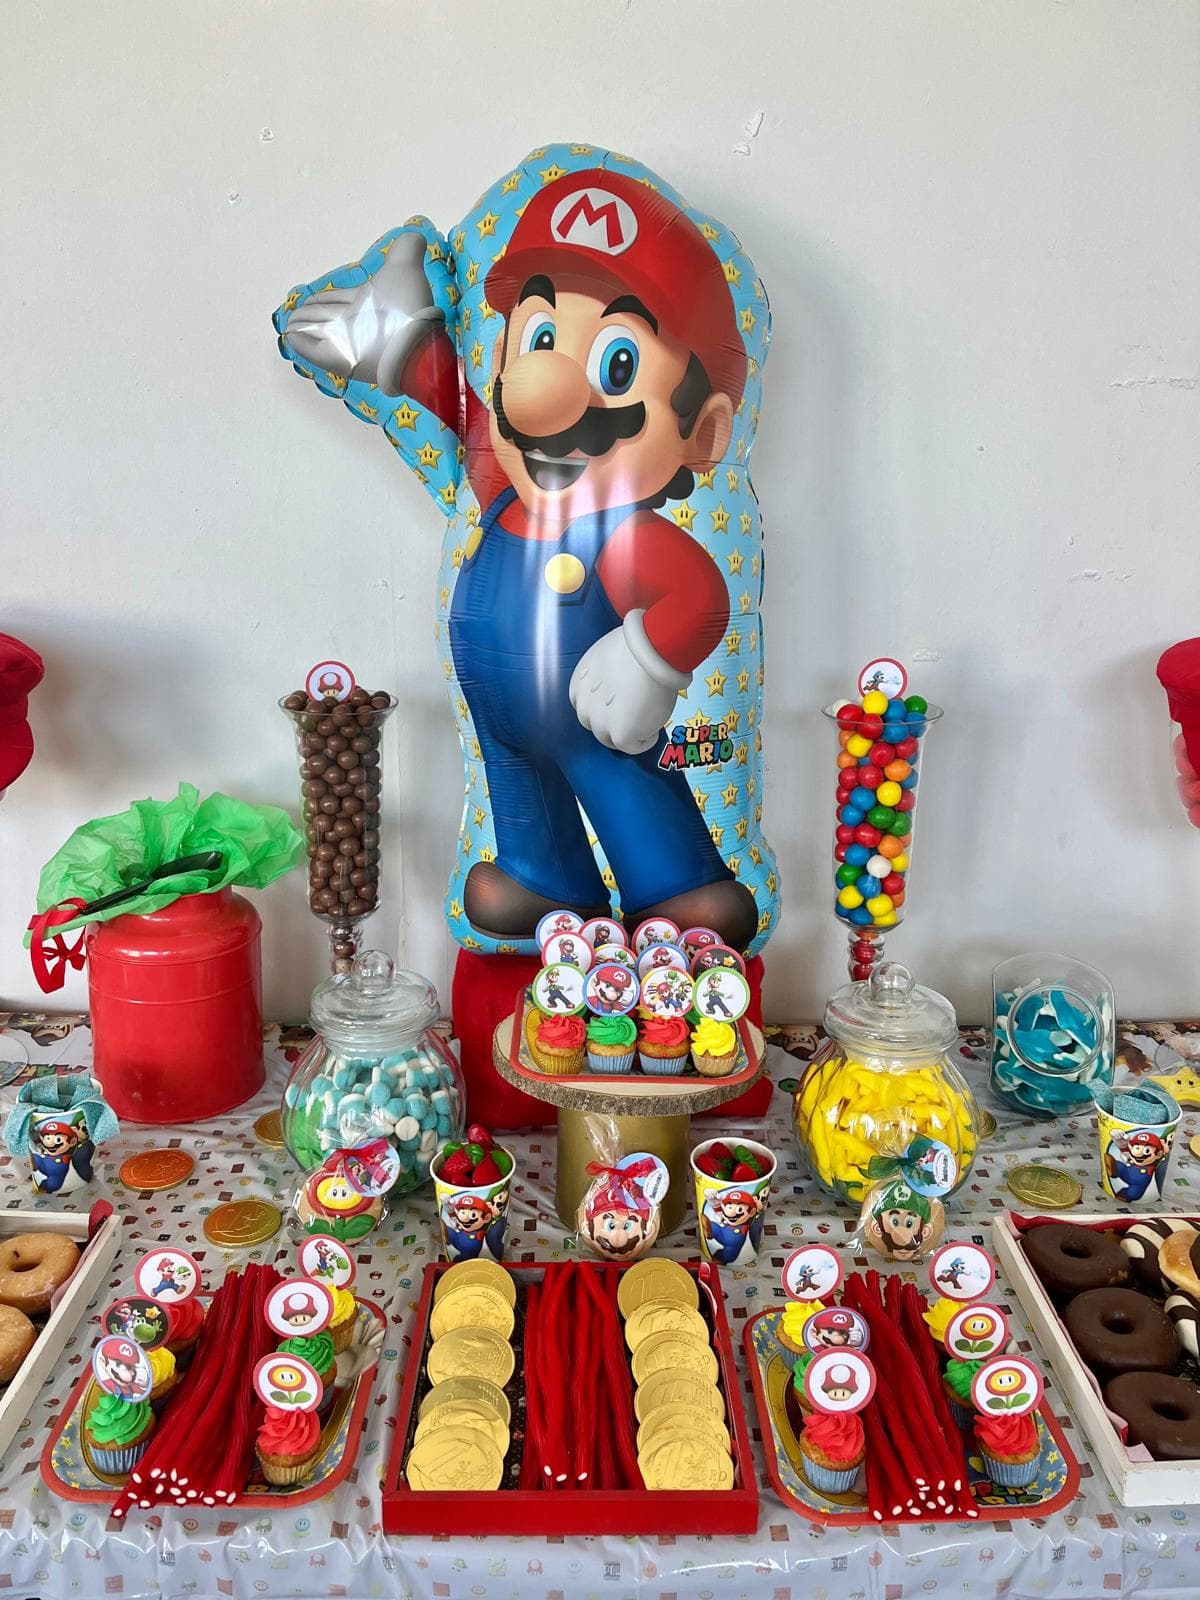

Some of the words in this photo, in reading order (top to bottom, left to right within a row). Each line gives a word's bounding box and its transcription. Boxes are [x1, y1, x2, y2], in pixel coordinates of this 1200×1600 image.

[557, 193, 624, 248] M
[671, 723, 728, 744] SUPER
[659, 740, 734, 769] MARIO
